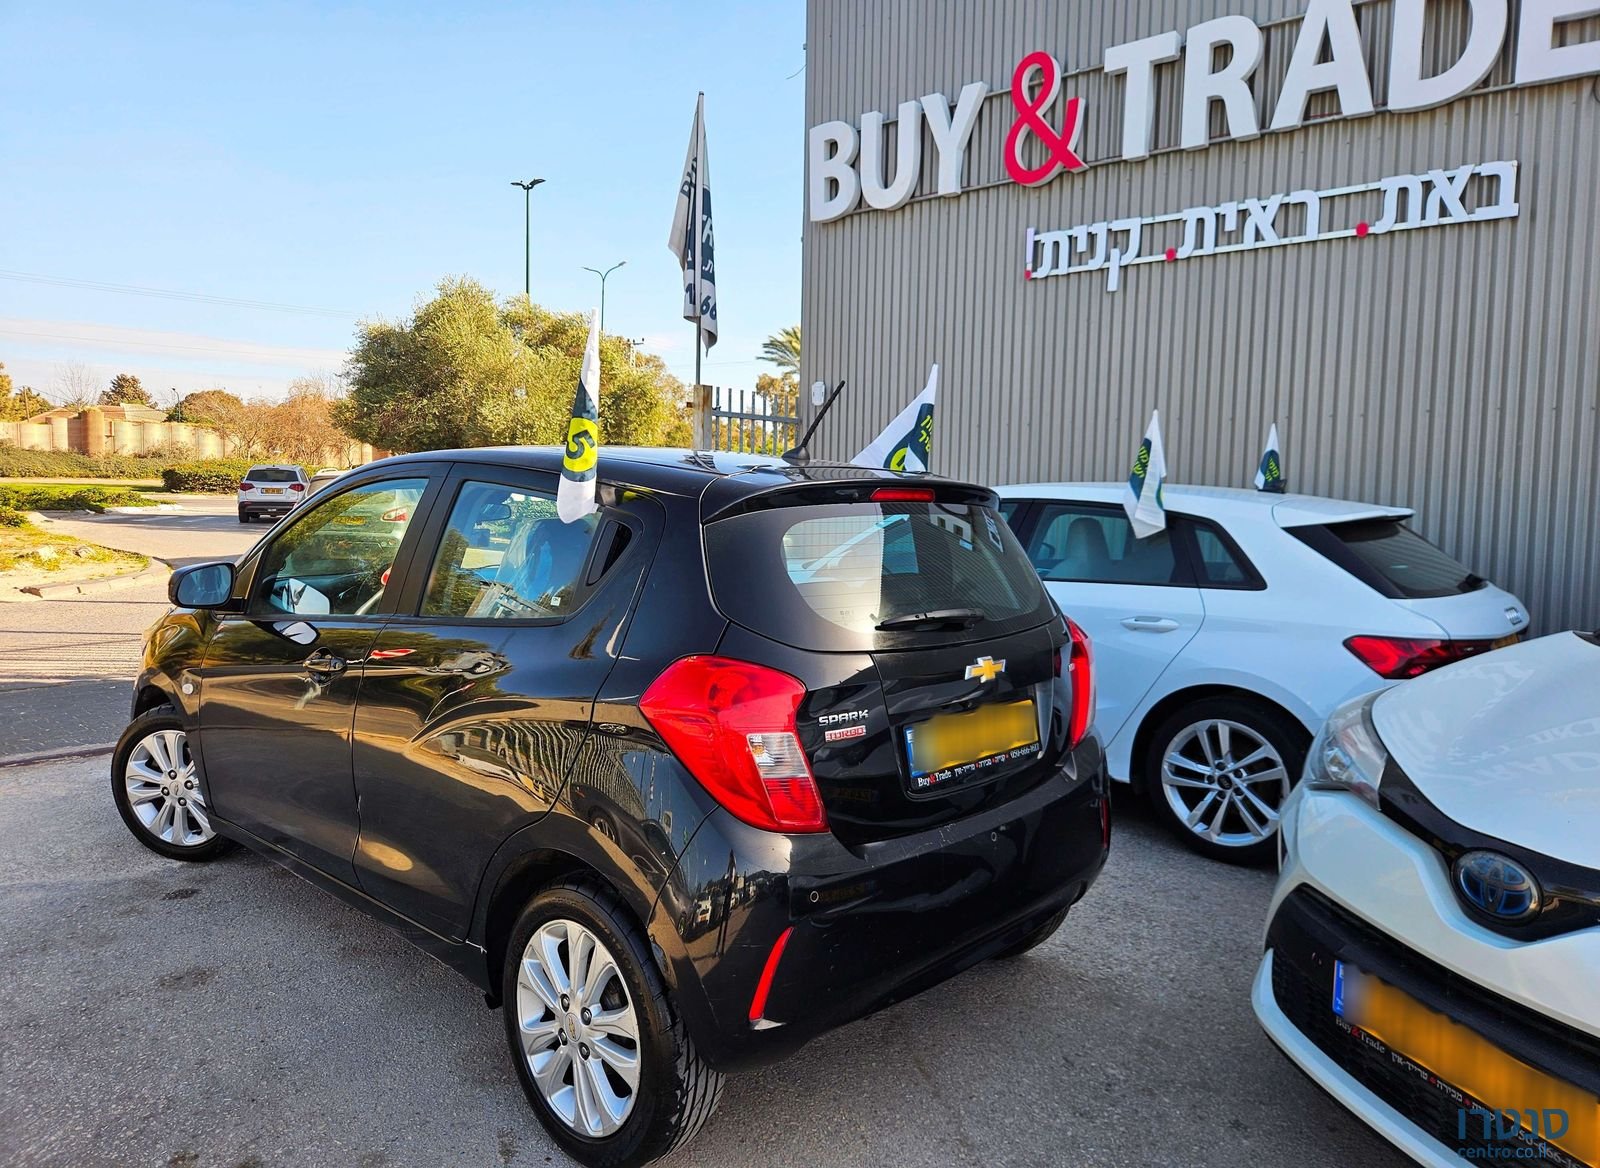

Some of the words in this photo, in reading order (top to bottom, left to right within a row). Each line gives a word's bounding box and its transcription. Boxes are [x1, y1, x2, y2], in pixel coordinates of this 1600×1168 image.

[809, 81, 989, 223] BUY
[1004, 50, 1088, 187] &
[1025, 217, 1142, 292] קנית!
[818, 709, 869, 726] SPARK
[825, 726, 866, 742] TURBO
[1335, 1016, 1385, 1053] Buy&Trade
